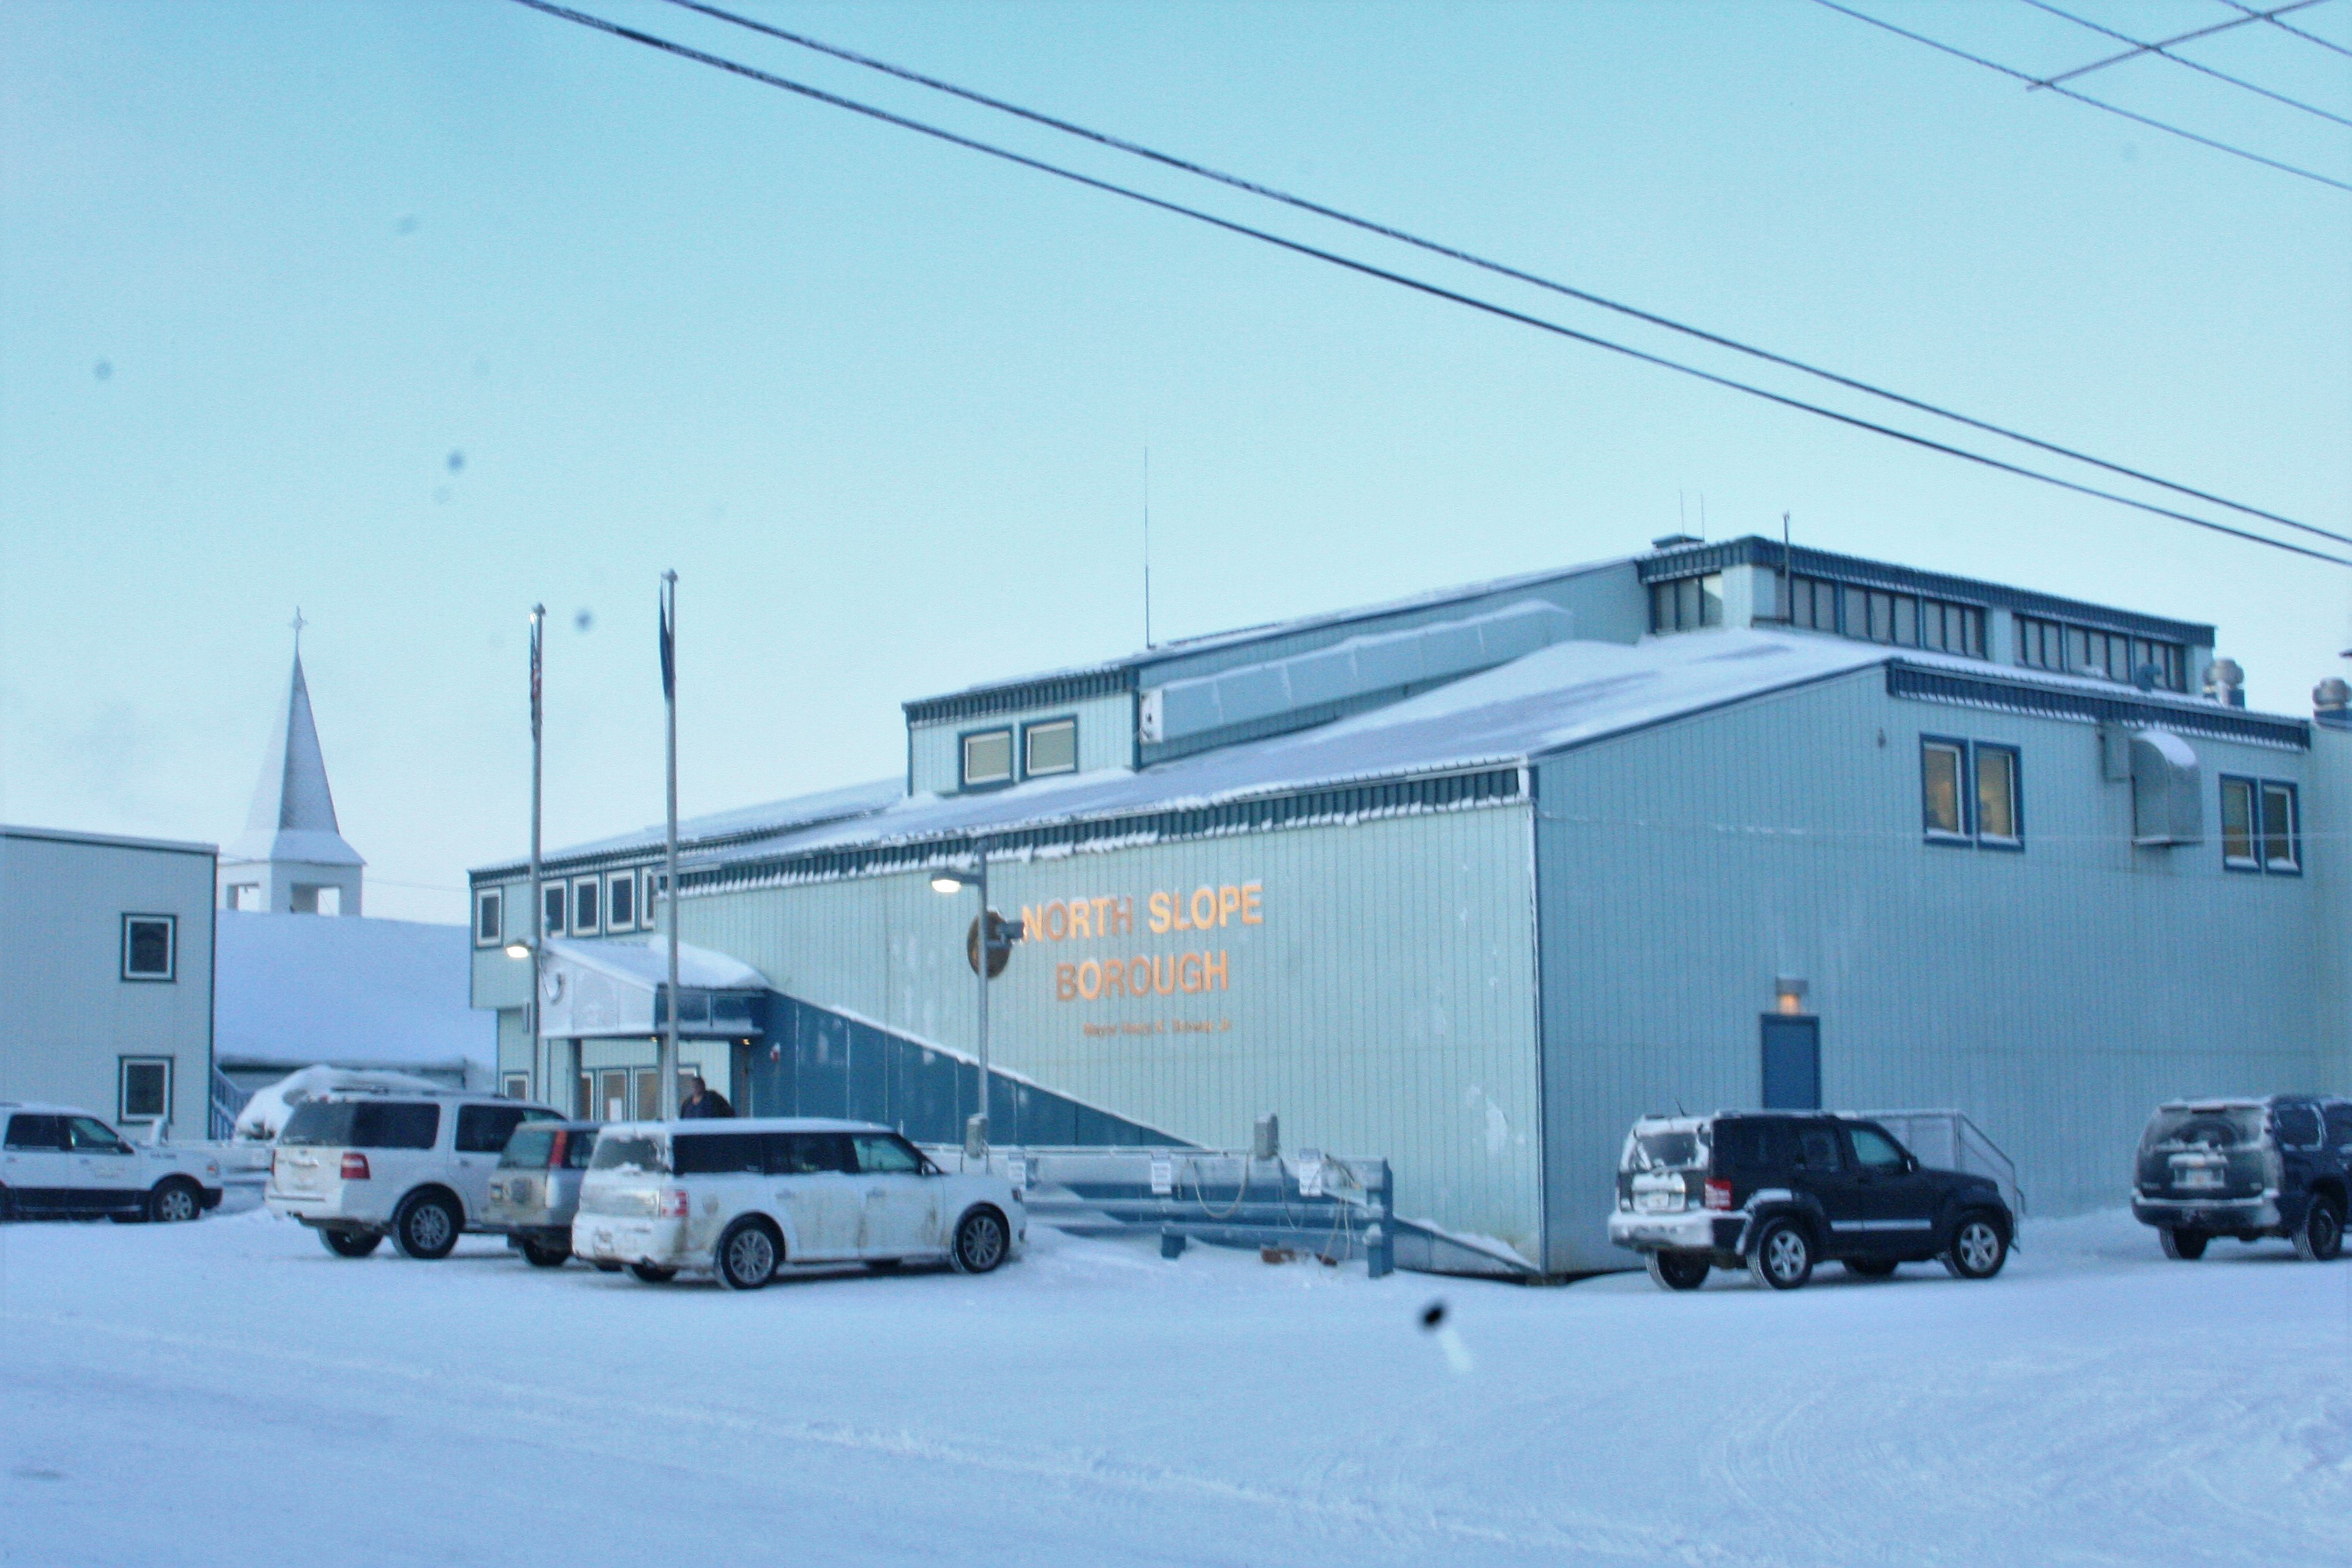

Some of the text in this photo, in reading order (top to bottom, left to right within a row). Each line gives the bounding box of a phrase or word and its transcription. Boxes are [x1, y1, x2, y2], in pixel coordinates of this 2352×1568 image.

[1022, 883, 1262, 942] NORTH SLOPE
[1056, 950, 1228, 1000] BOROUGH
